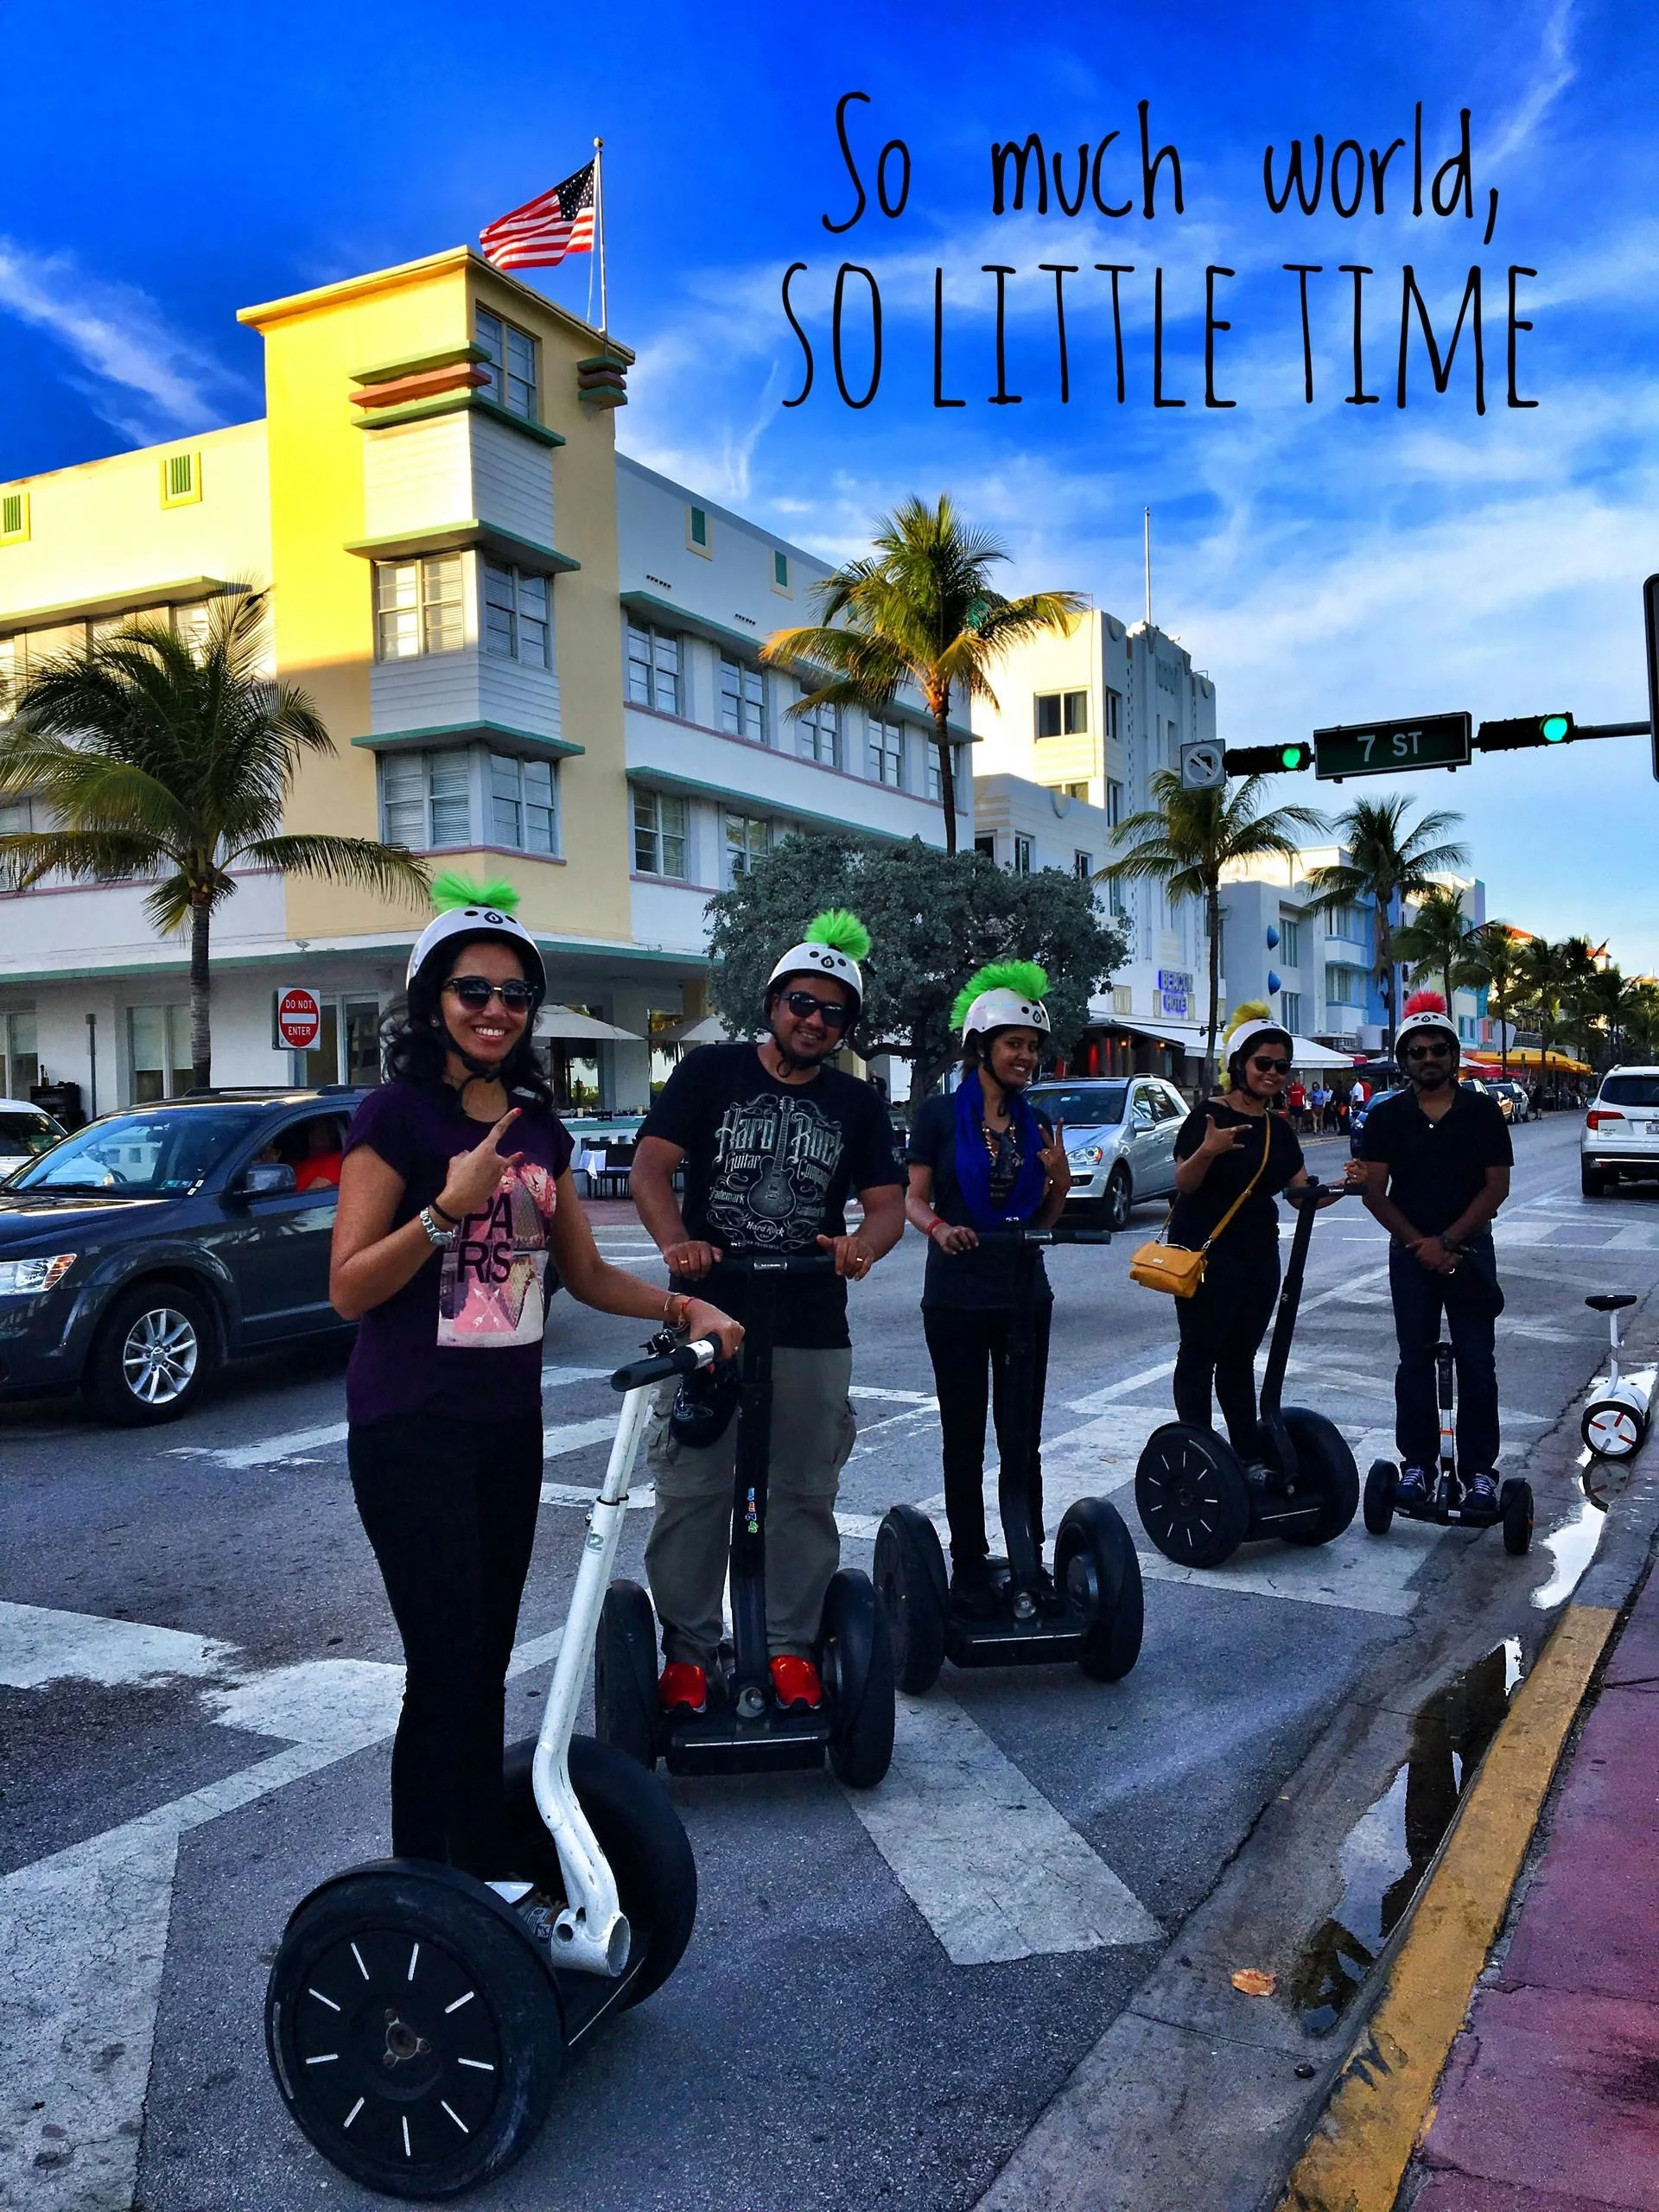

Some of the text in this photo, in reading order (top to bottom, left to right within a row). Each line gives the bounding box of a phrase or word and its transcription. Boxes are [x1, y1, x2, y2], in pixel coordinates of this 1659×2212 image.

[1357, 731, 1423, 762] 7 ST
[1159, 969, 1193, 992] BEACON
[285, 1000, 313, 1009] DO NOT
[289, 1026, 311, 1036] ENTER
[724, 1153, 761, 1173] Guitar
[457, 1240, 512, 1284] RIS
